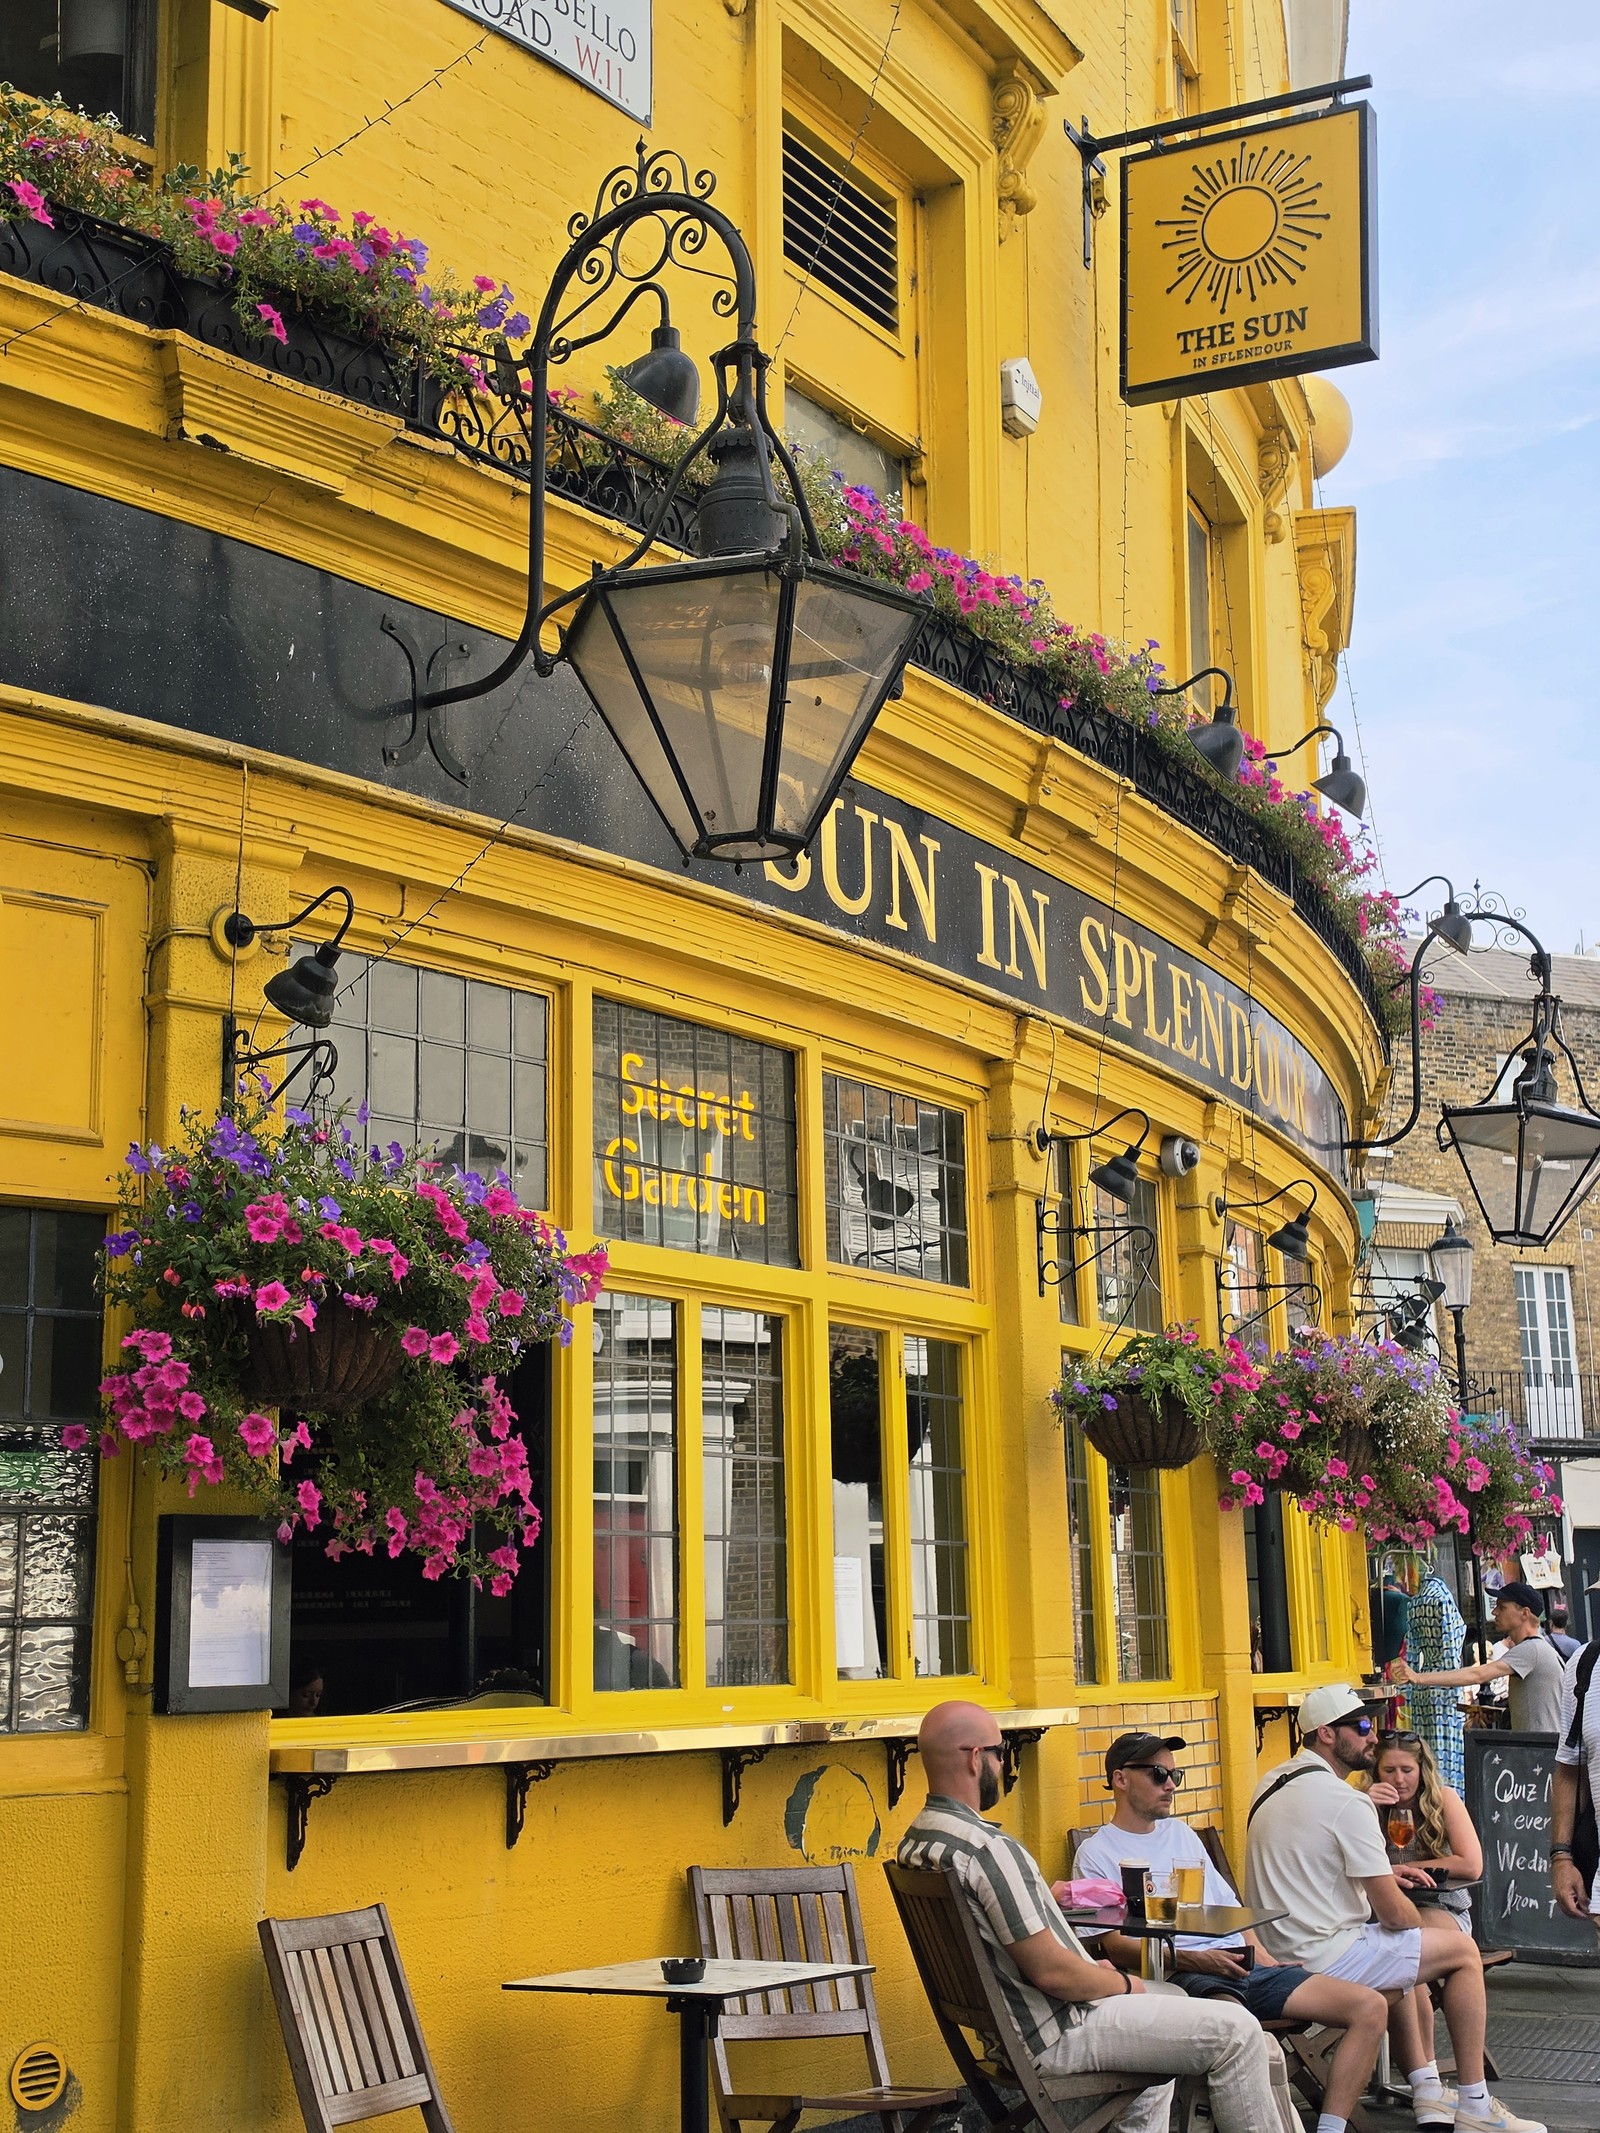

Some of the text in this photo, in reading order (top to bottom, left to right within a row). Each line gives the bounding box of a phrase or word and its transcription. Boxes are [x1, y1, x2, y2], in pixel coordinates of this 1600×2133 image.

[1176, 306, 1309, 355] THE SUN
[1192, 339, 1293, 369] IN SPLENDOUR
[974, 861, 1050, 991] IN
[1079, 916, 1309, 1138] SPLENDOUR
[621, 1052, 755, 1141] Secret
[604, 1137, 766, 1226] Garden
[1496, 1840, 1551, 1873] Wedn
